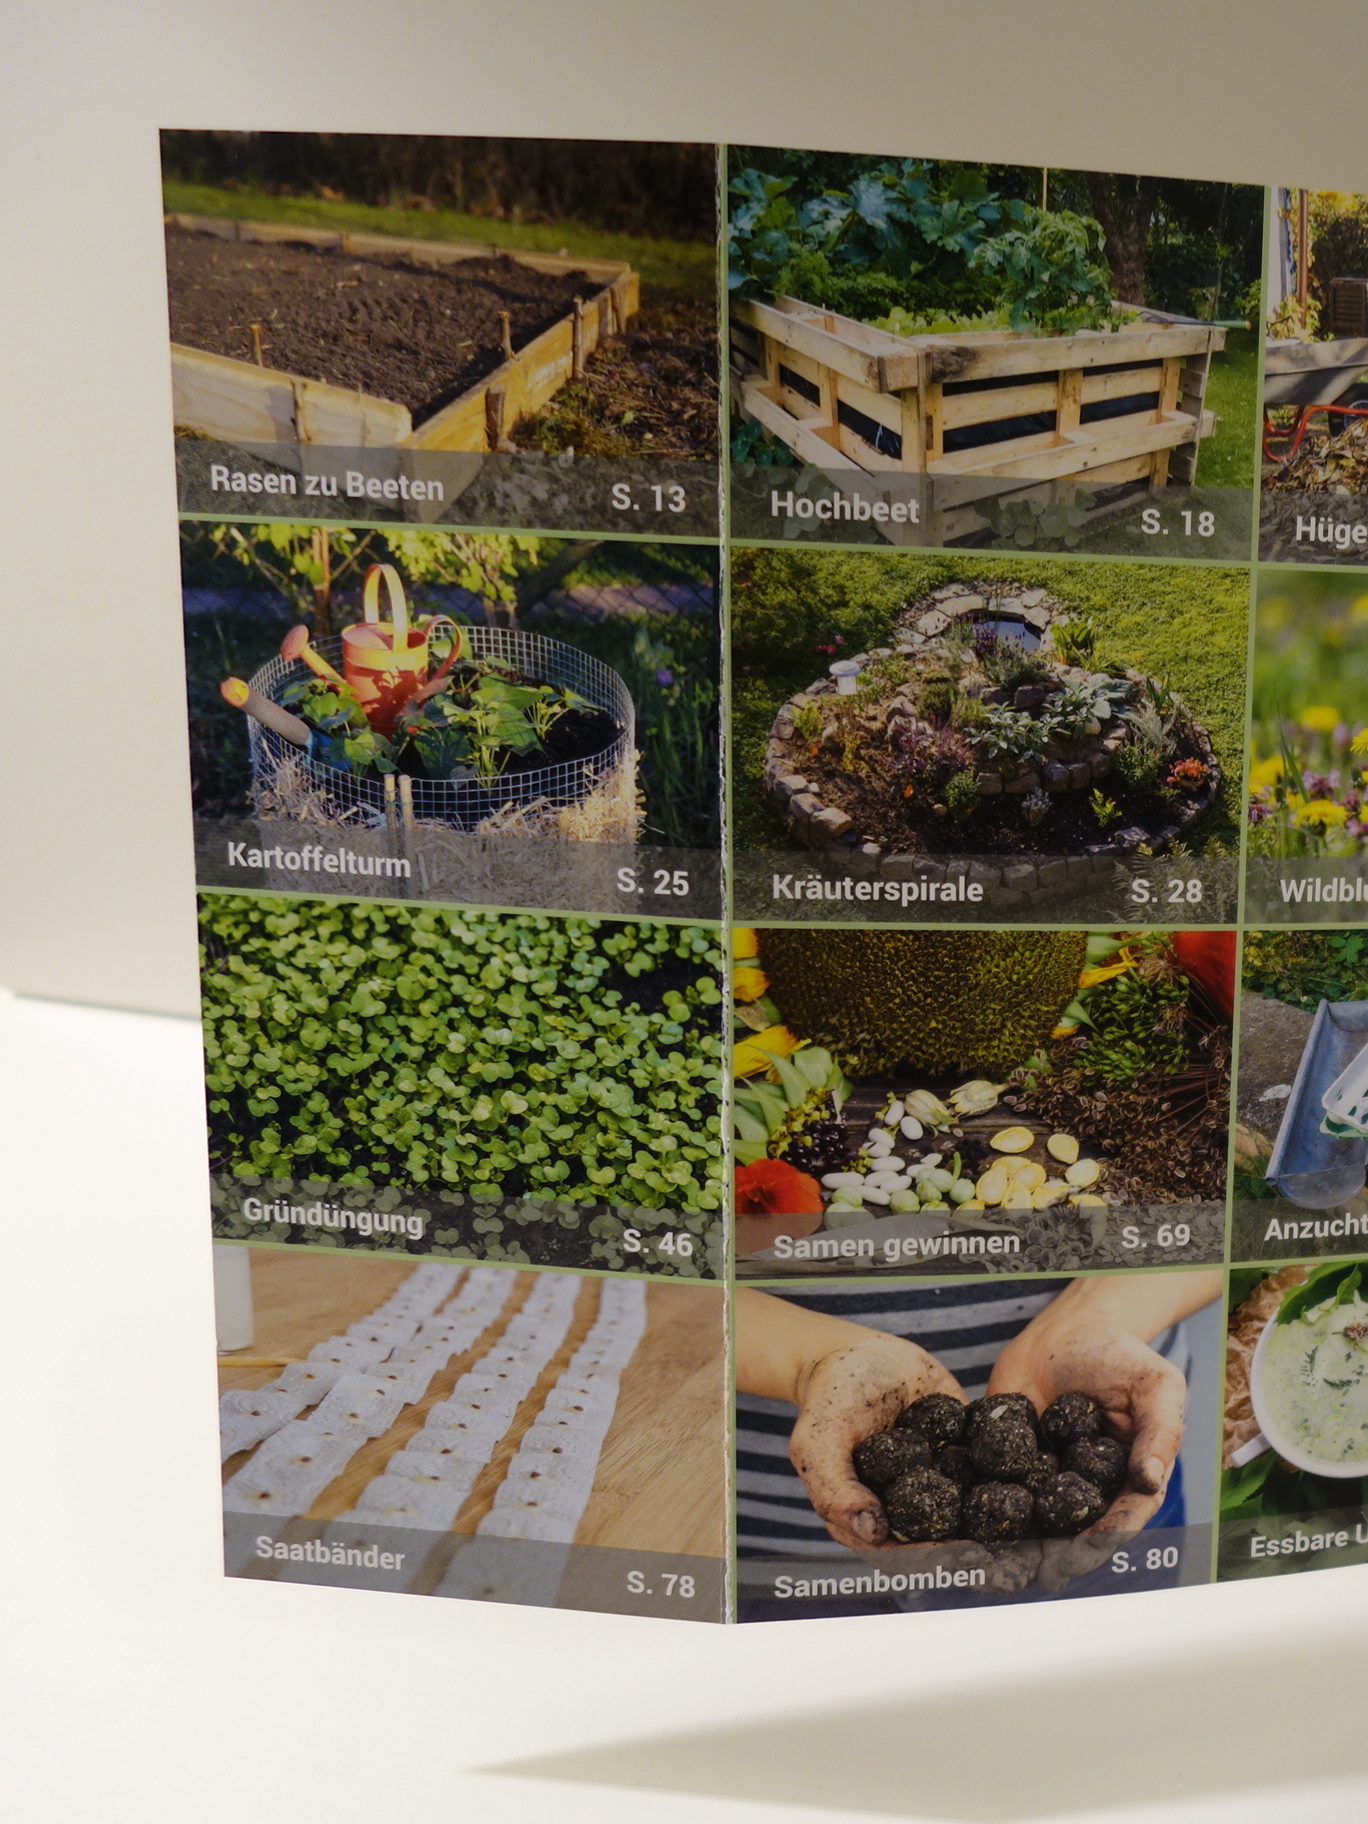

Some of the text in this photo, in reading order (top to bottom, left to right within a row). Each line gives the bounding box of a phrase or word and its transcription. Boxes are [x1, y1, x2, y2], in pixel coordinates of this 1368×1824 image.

[210, 465, 444, 502] Rasen zu Beeten
[612, 484, 687, 513] S. 13
[771, 490, 919, 524] Hochbeet
[1141, 508, 1215, 537] S. 18
[227, 842, 411, 878] Kartoffelturm
[617, 867, 690, 897] S. 25
[772, 874, 984, 907] Kräuterspirale
[1131, 879, 1203, 904] S. 28
[243, 1197, 423, 1241] Gründüngung
[623, 1228, 693, 1258] S. 46
[774, 1230, 1020, 1263] Samen gewinnen
[1121, 1223, 1191, 1251] S. 69
[256, 1535, 406, 1572] Saatbänder
[1250, 1526, 1348, 1559] Essbare
[1111, 1545, 1179, 1575] S. 80
[626, 1570, 696, 1599] S. 78
[774, 1565, 986, 1599] Samenbomben
